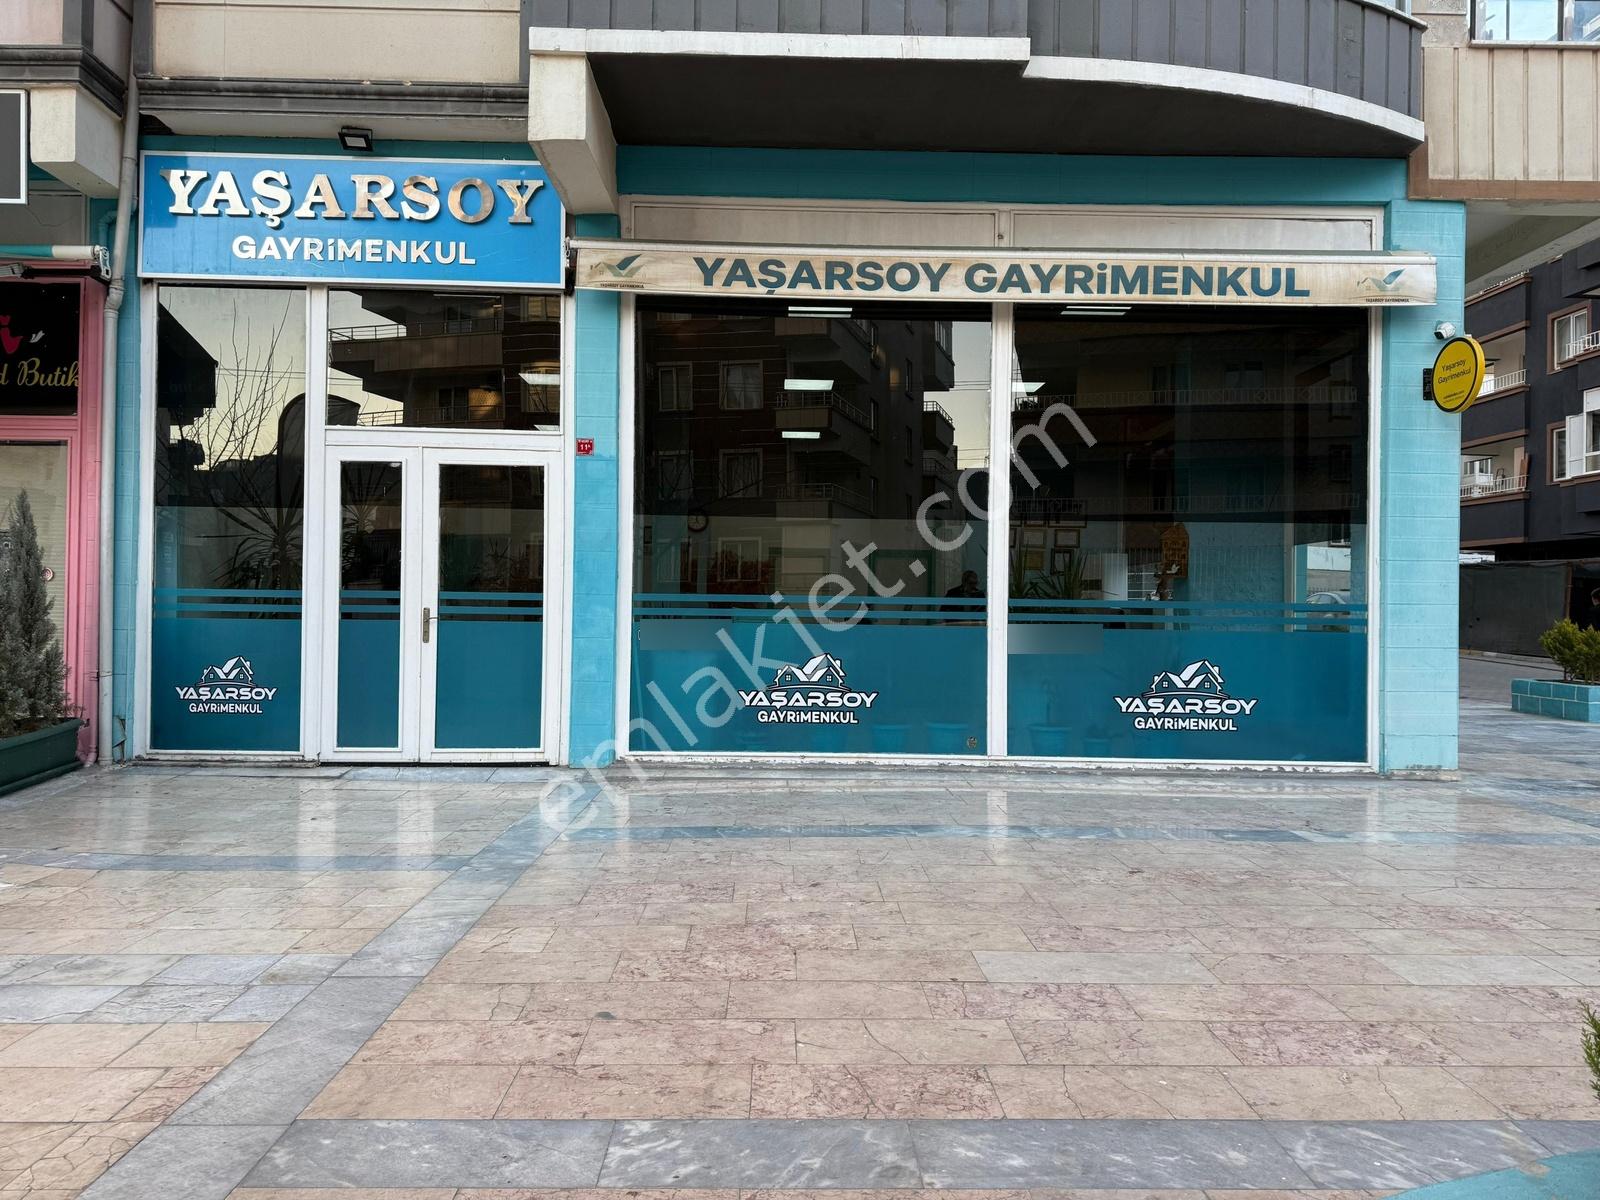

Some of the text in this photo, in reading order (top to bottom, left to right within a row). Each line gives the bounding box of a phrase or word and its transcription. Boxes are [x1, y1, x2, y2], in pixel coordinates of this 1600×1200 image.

[160, 168, 544, 229] YAŞARSOY
[693, 257, 953, 296] YAŞARSOY
[17, 357, 80, 387] Butik
[176, 687, 277, 701] YAŞARSOY
[738, 690, 878, 709] YAŞARSOY
[1114, 696, 1258, 716] YAŞARSOY
